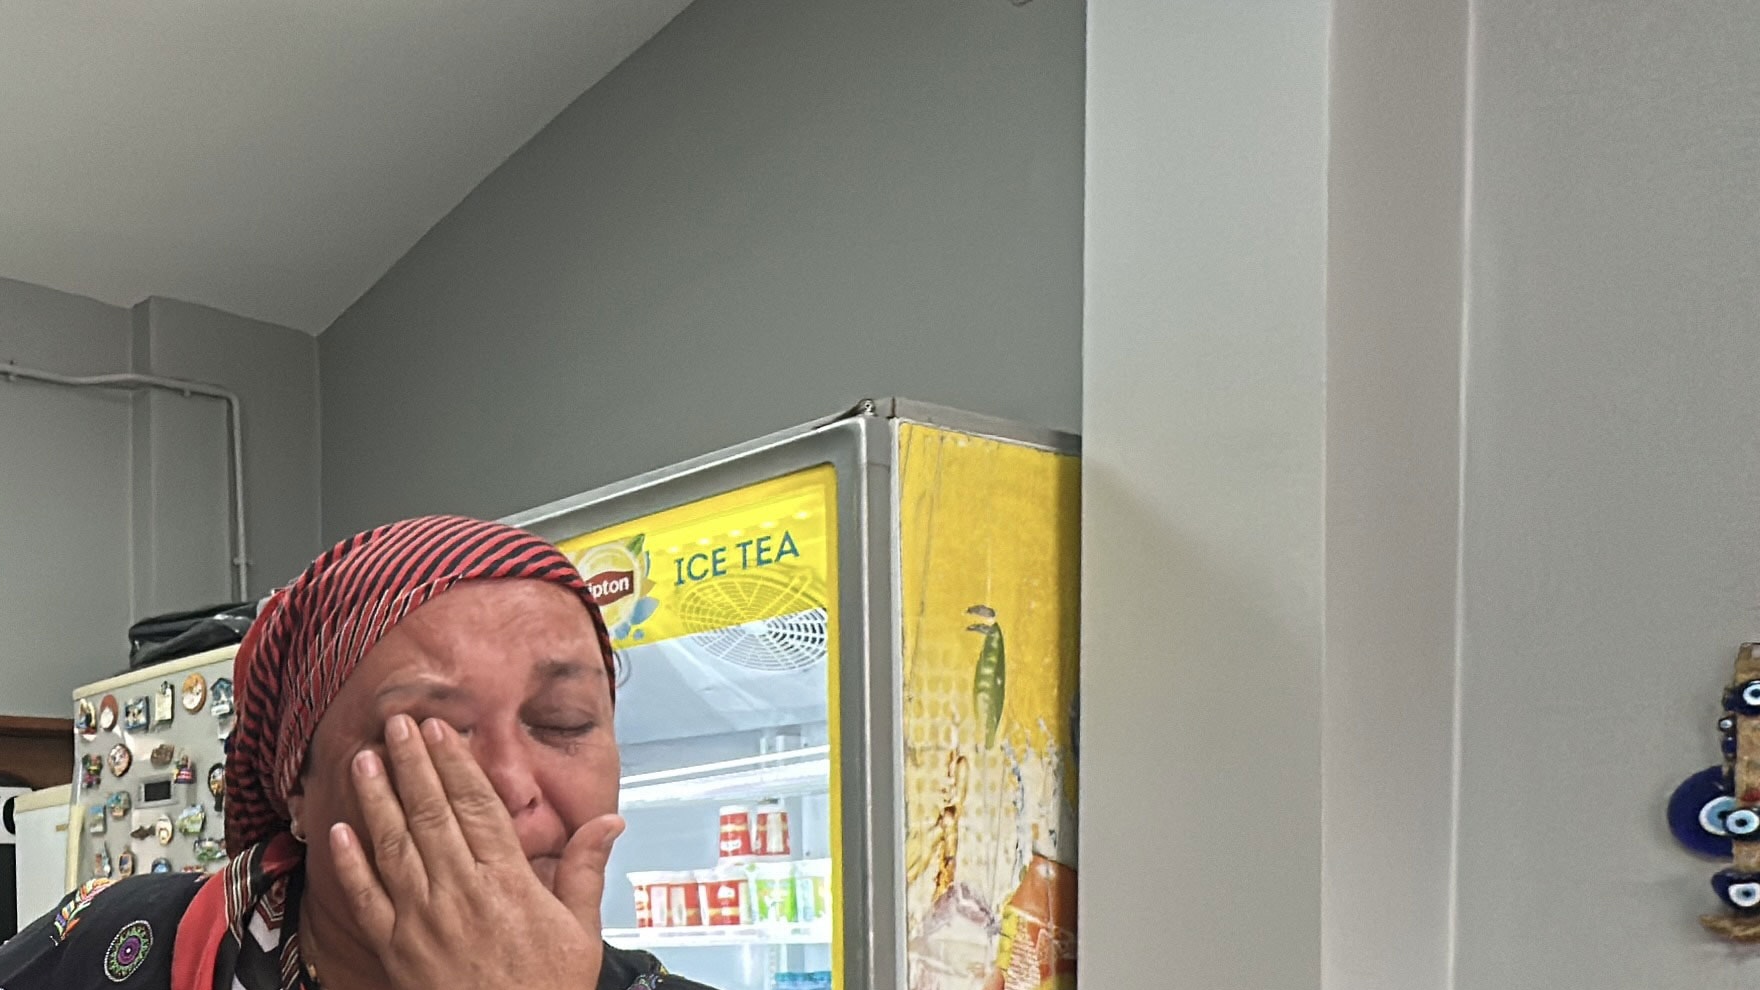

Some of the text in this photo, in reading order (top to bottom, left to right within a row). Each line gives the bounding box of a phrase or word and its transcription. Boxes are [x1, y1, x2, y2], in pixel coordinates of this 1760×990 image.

[673, 530, 800, 586] ICE TEA
[587, 576, 630, 600] ipton
